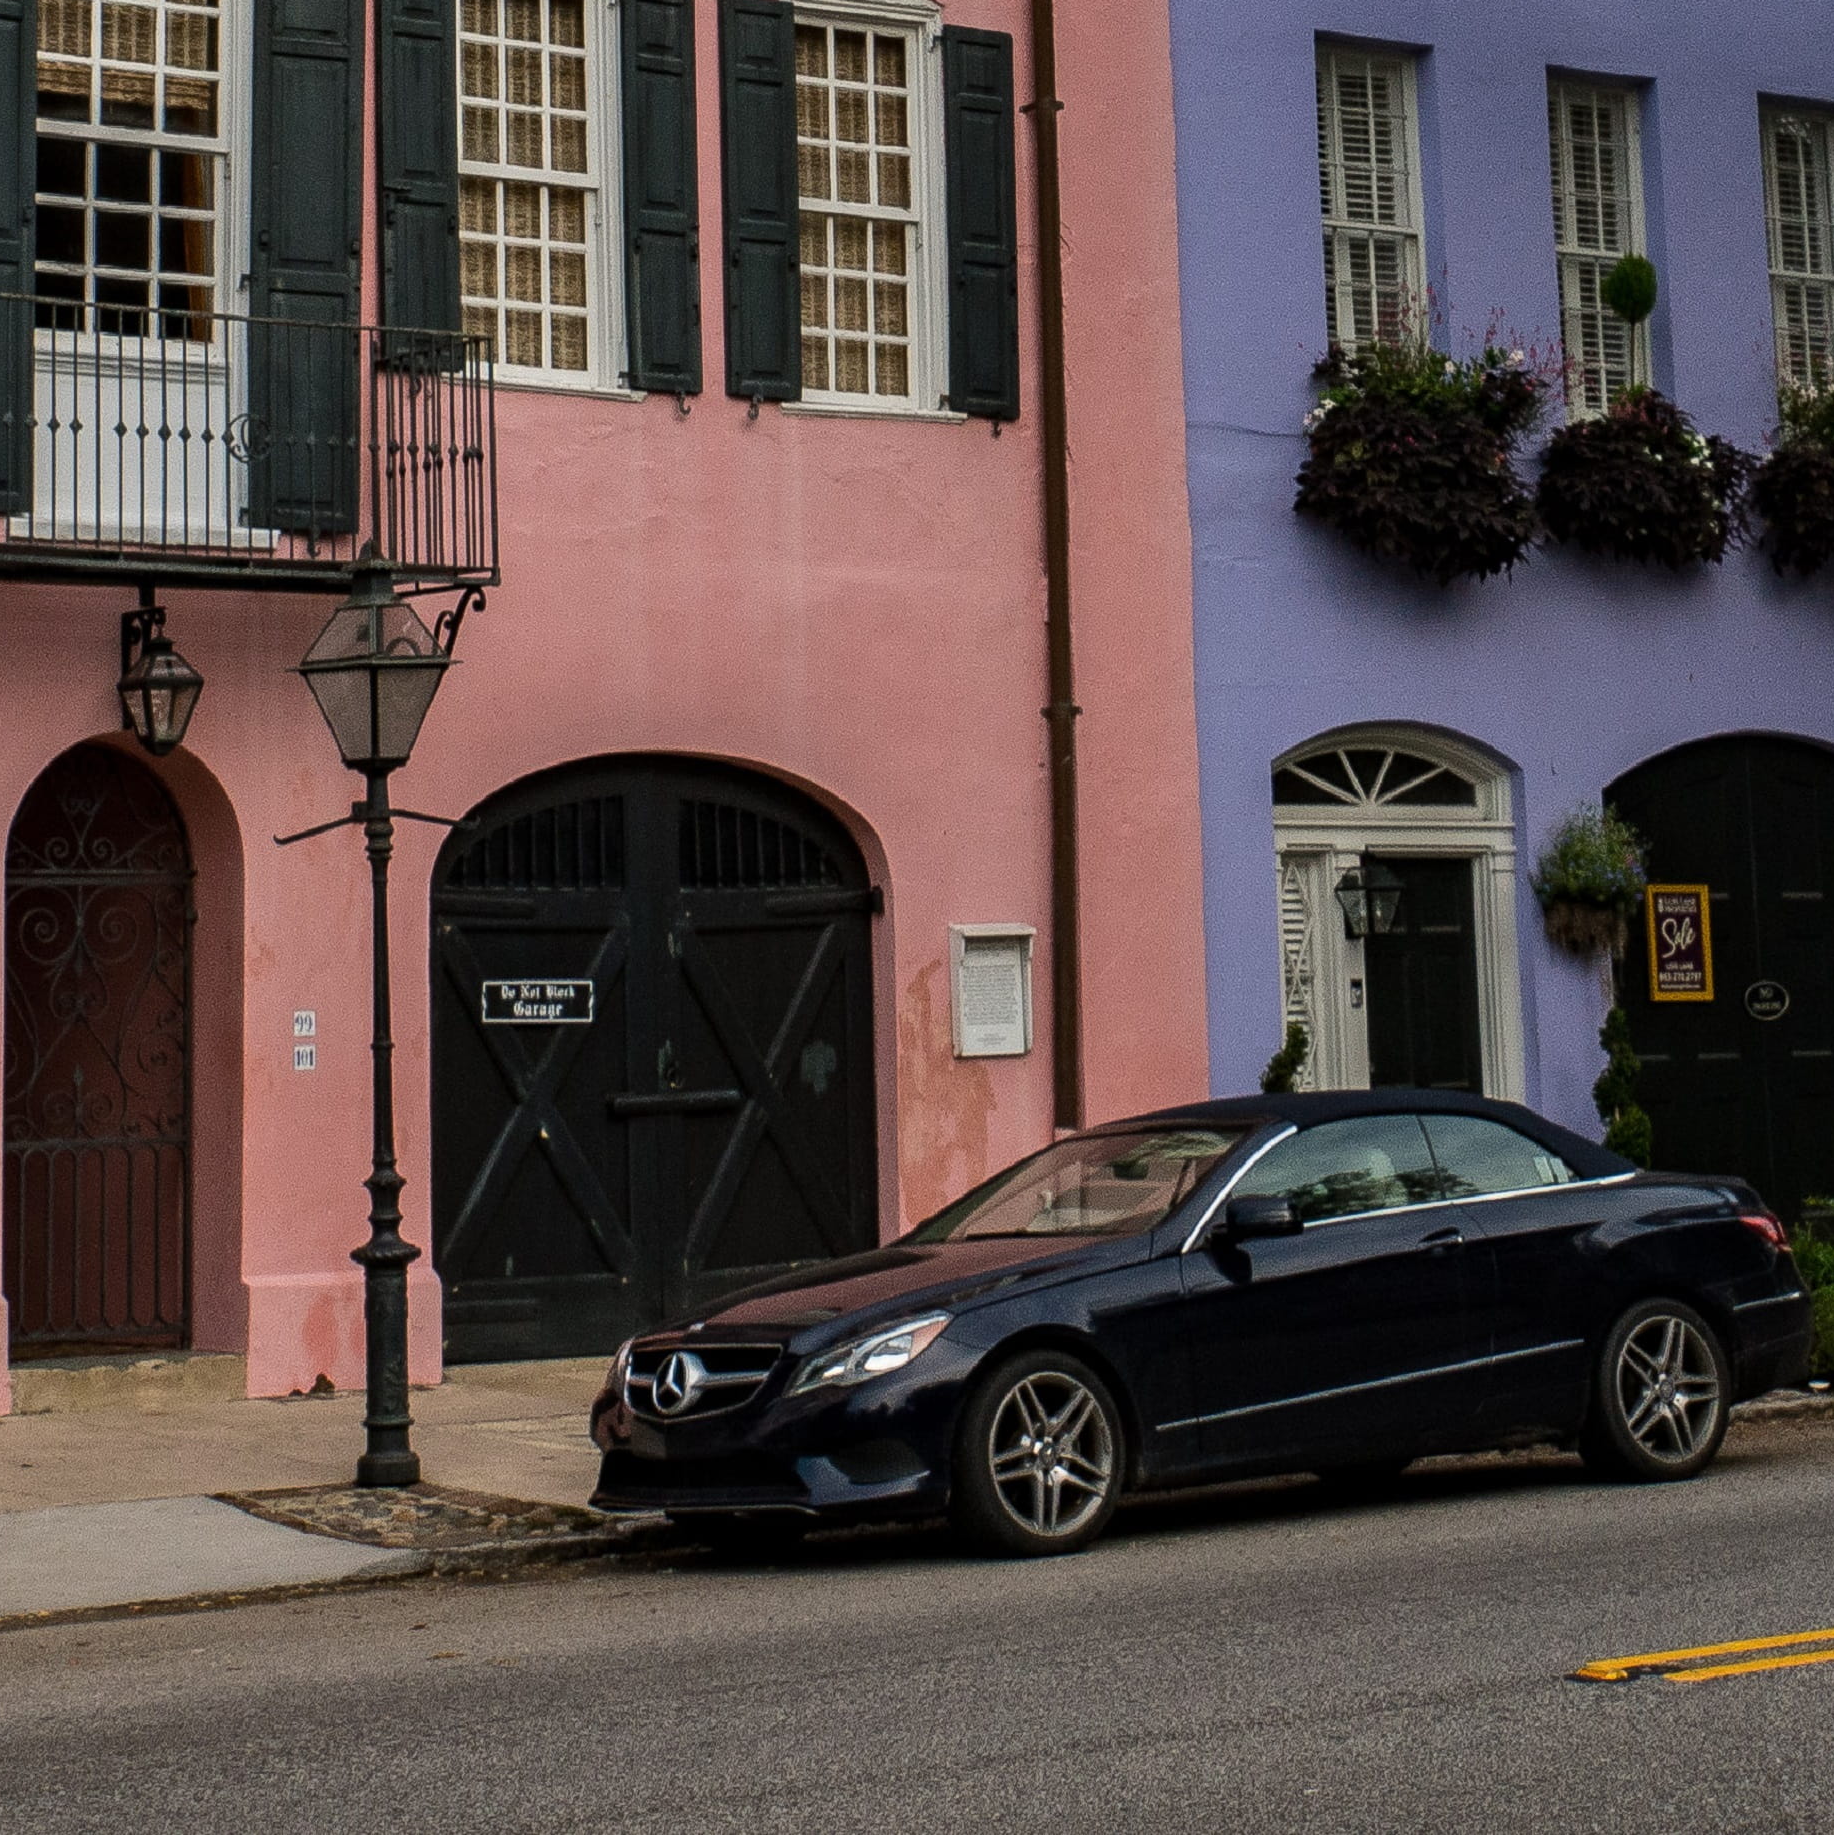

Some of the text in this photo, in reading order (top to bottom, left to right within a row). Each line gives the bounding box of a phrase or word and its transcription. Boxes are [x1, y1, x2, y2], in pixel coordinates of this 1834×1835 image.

[1662, 917, 1696, 959] Sale
[501, 985, 575, 999] Do Not Block
[513, 1000, 563, 1020] Garage
[295, 1014, 313, 1032] 99
[297, 1049, 314, 1067] 101
